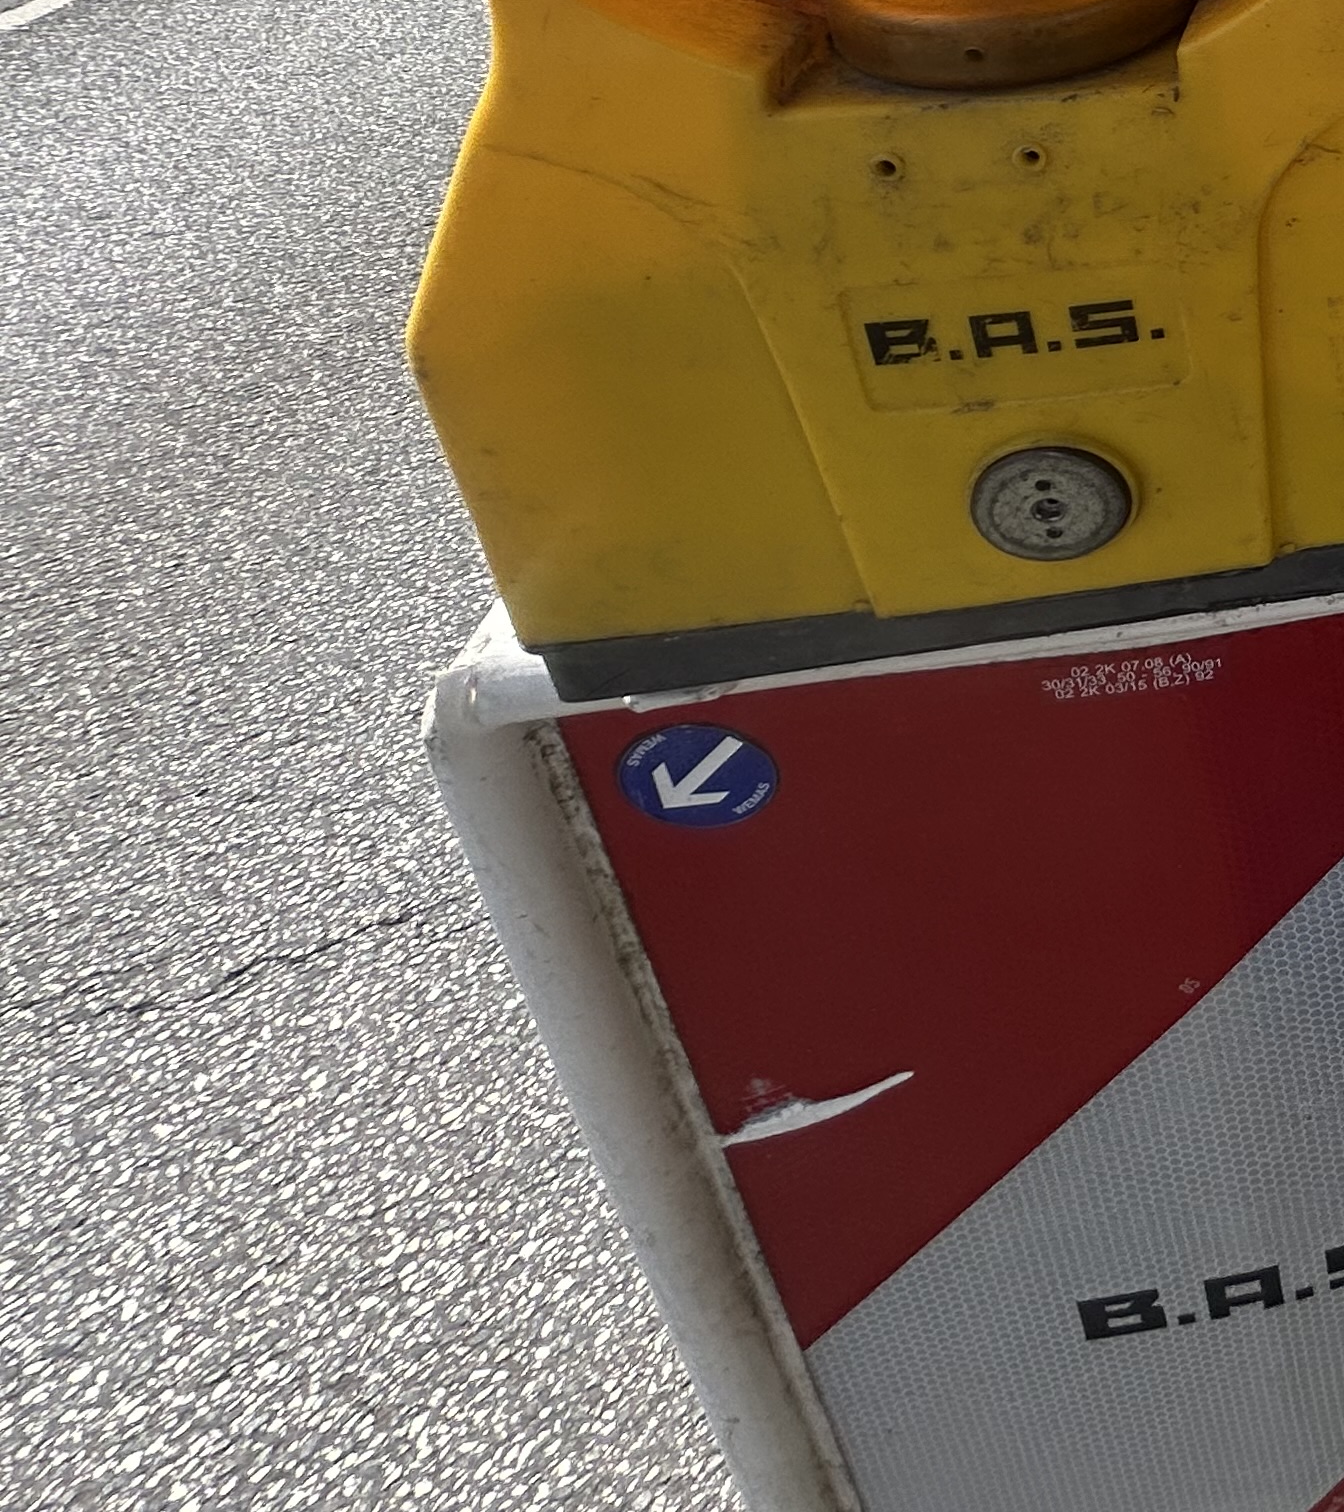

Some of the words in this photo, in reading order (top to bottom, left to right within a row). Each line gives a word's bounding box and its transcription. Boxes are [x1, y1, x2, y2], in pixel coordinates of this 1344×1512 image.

[863, 298, 1167, 367] B.A.S.
[1071, 666, 1090, 678] 02
[1096, 662, 1117, 677] 2K
[1168, 652, 1193, 668] (A)
[1117, 671, 1136, 684] 50
[1054, 688, 1076, 700] 02
[1080, 685, 1101, 698] 2K
[626, 733, 668, 768] WEMAS
[731, 781, 771, 816] WEMAS
